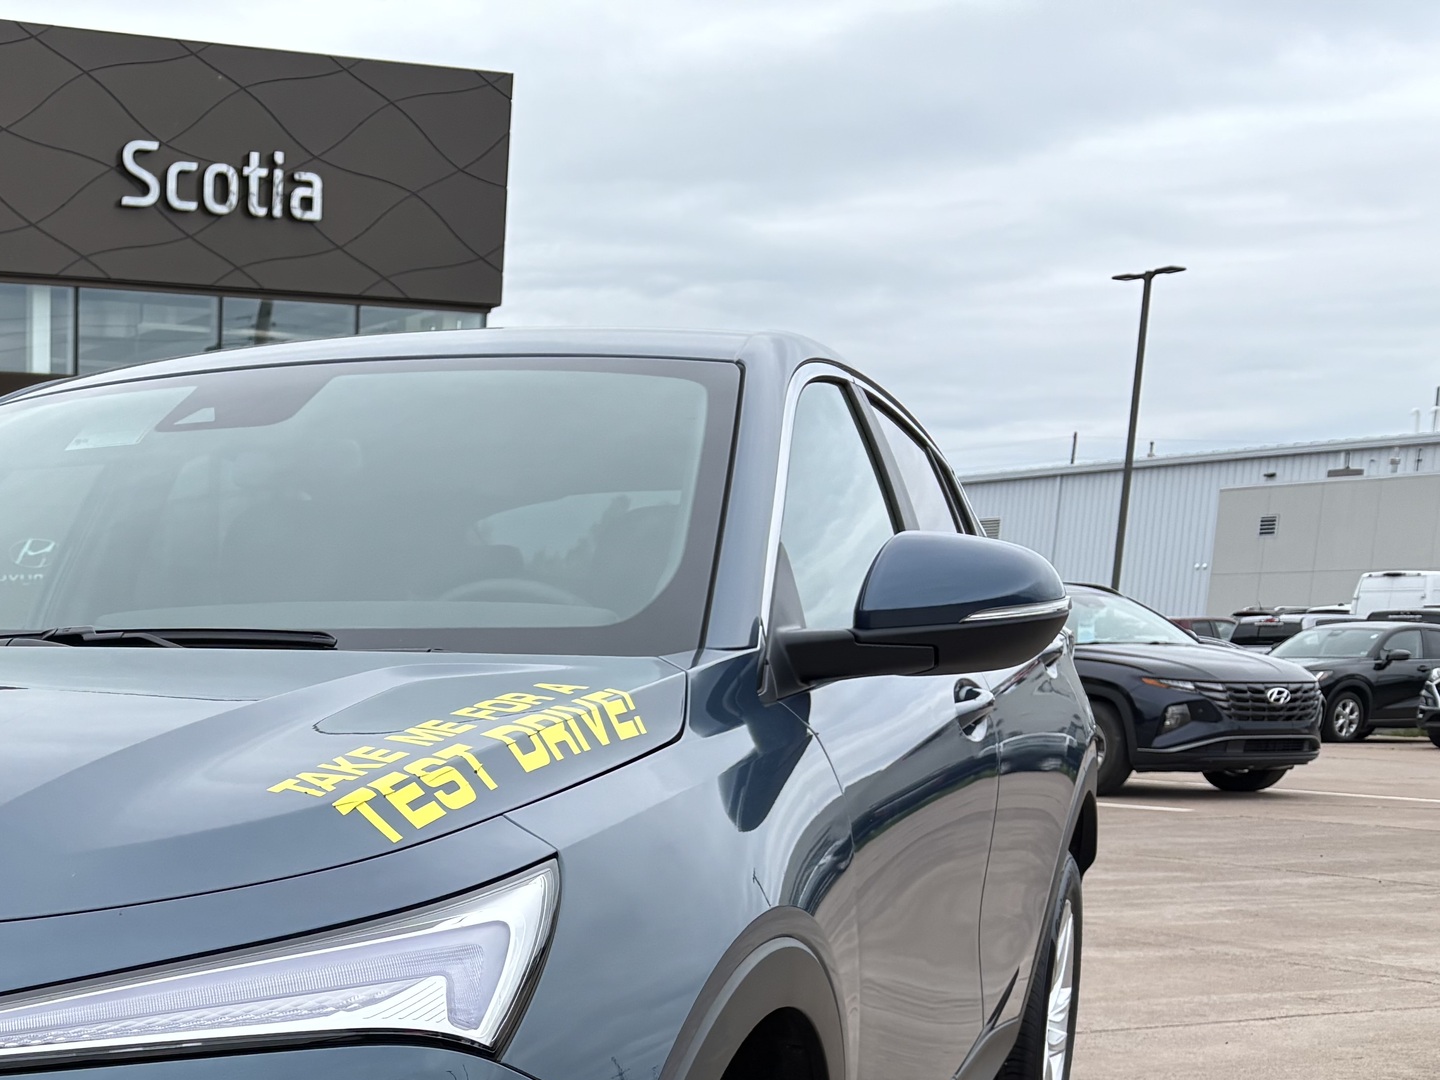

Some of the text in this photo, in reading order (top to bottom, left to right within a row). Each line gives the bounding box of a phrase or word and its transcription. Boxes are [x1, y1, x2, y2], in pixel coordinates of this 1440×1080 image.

[120, 139, 324, 222] Scotia
[266, 682, 590, 798] TAKE ME FOR A
[331, 688, 648, 844] TEST DRIVE!
